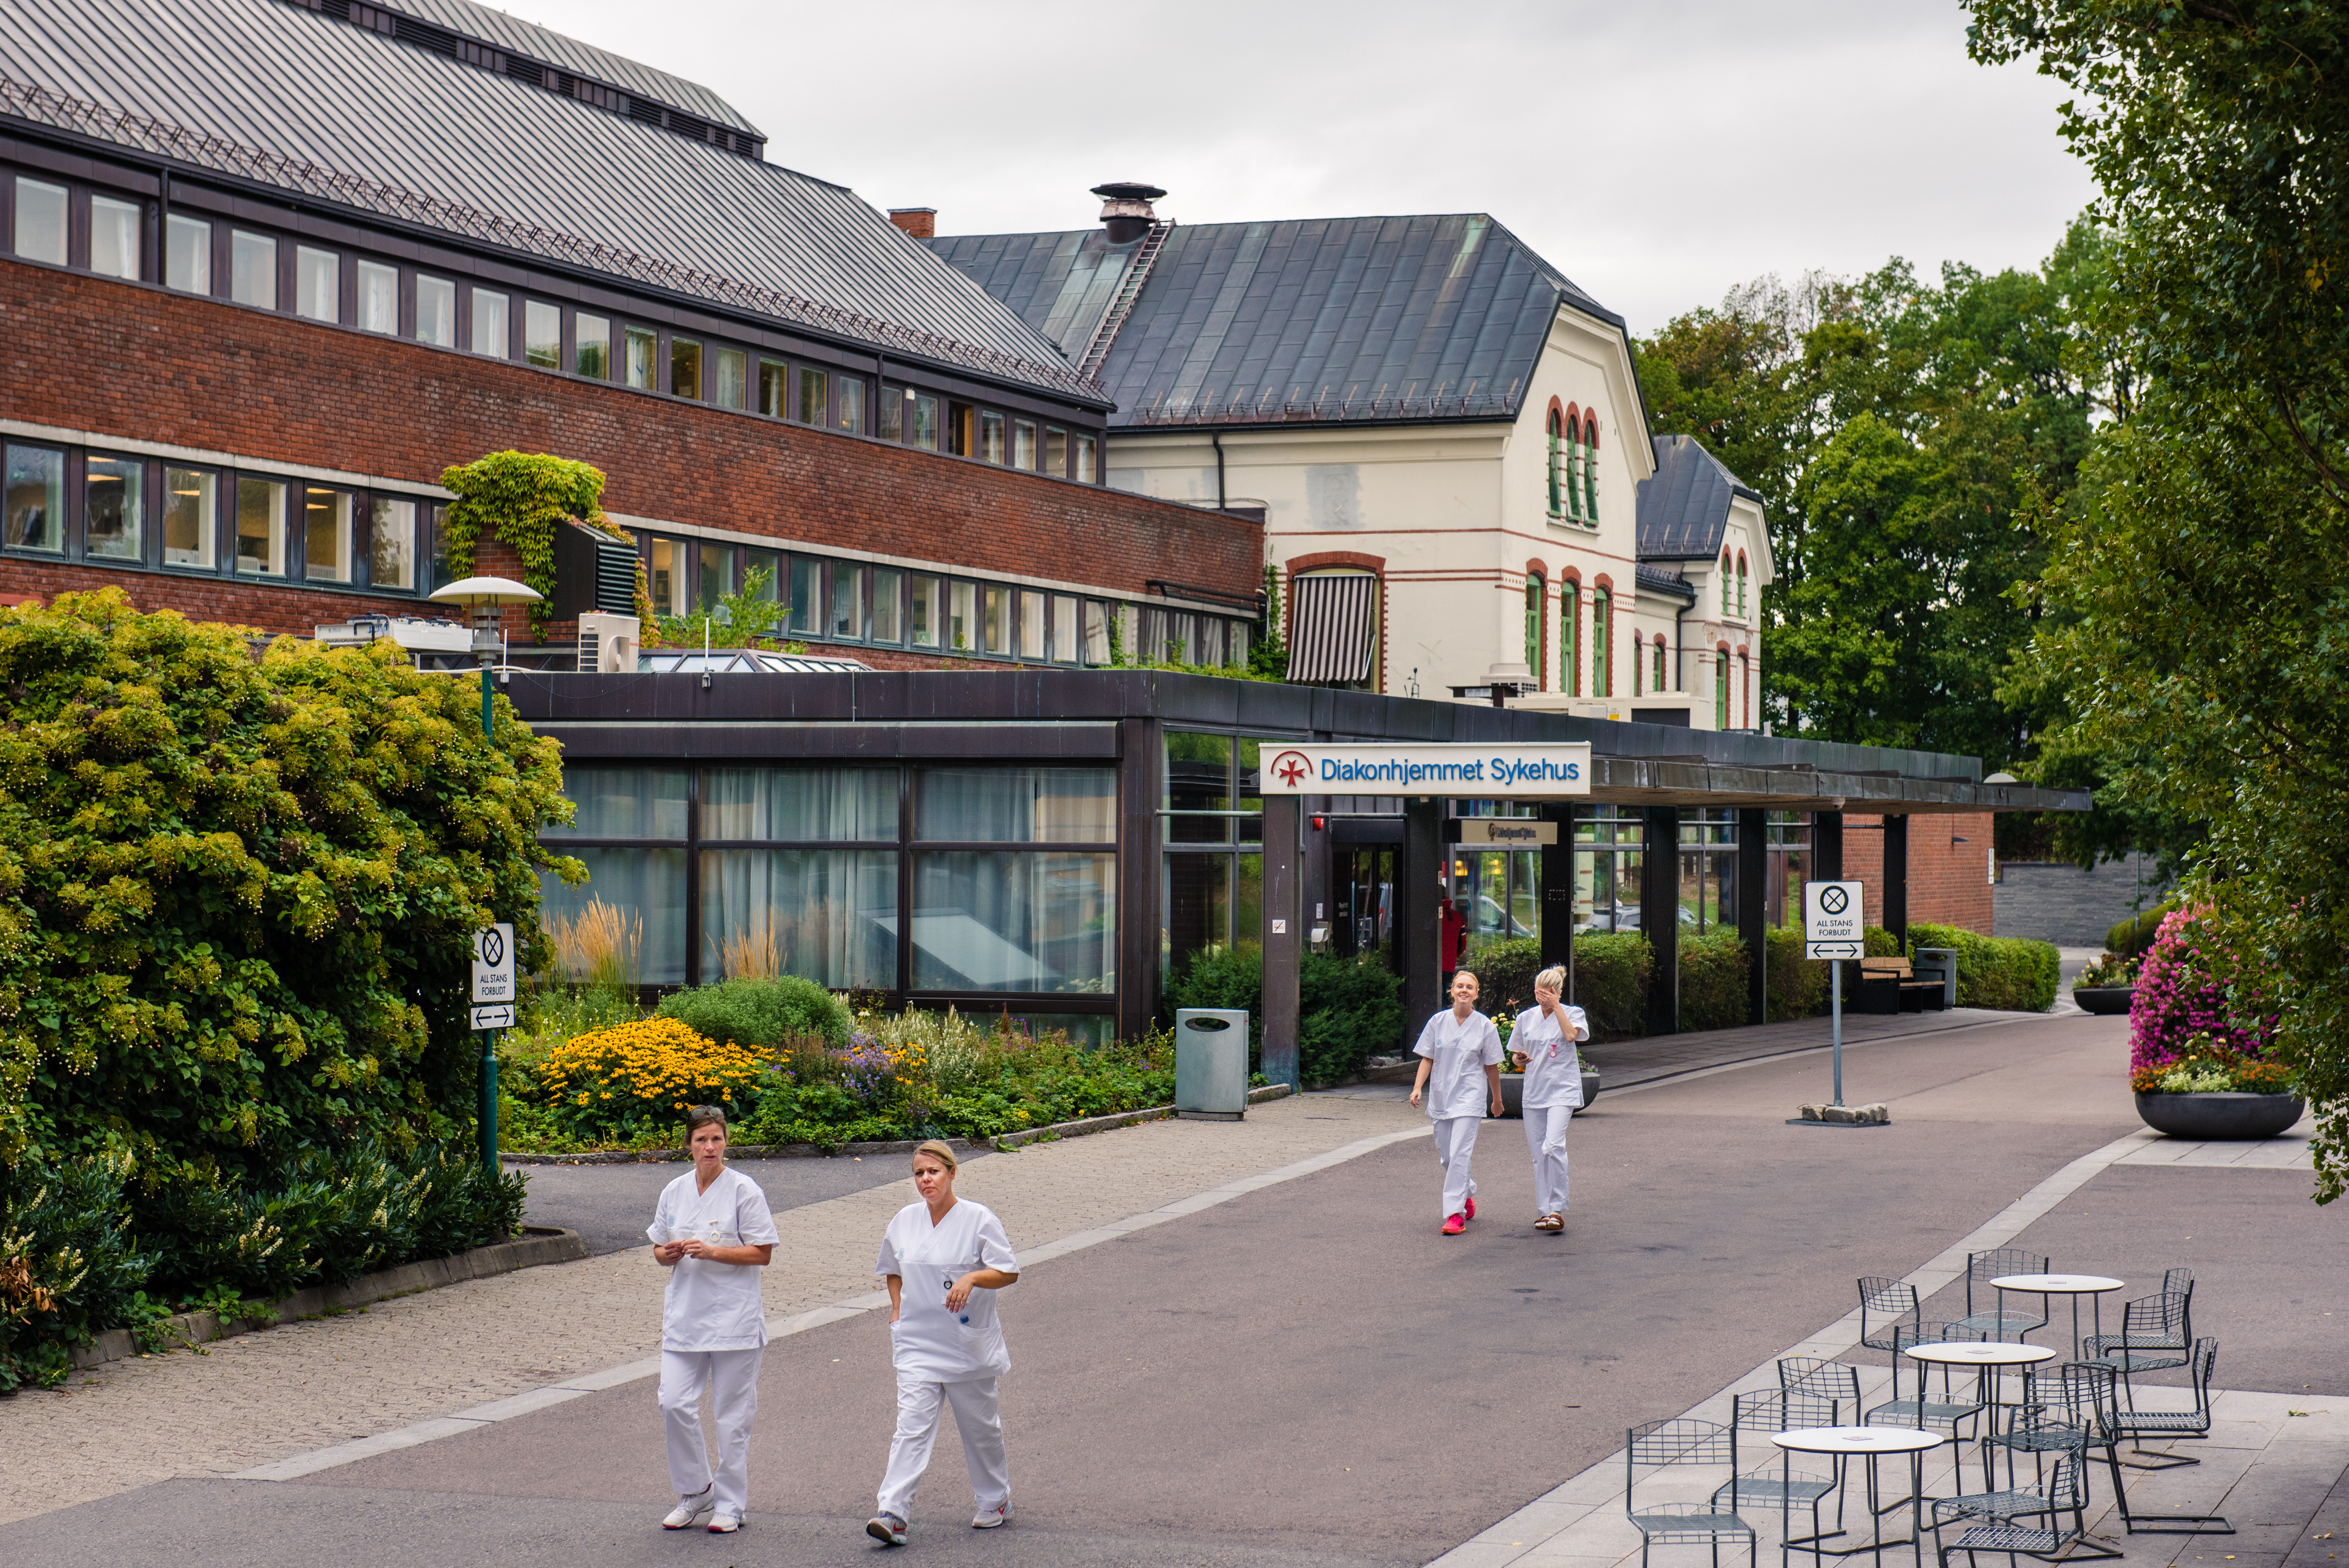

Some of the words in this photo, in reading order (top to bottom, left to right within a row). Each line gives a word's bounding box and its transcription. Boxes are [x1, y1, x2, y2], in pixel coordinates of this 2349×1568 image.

[1321, 758, 1483, 785] Diakonhjemmet
[1491, 758, 1579, 785] Sykehus
[480, 975, 489, 984] ALL
[490, 974, 507, 983] STANS
[482, 986, 506, 996] FORBUDT
